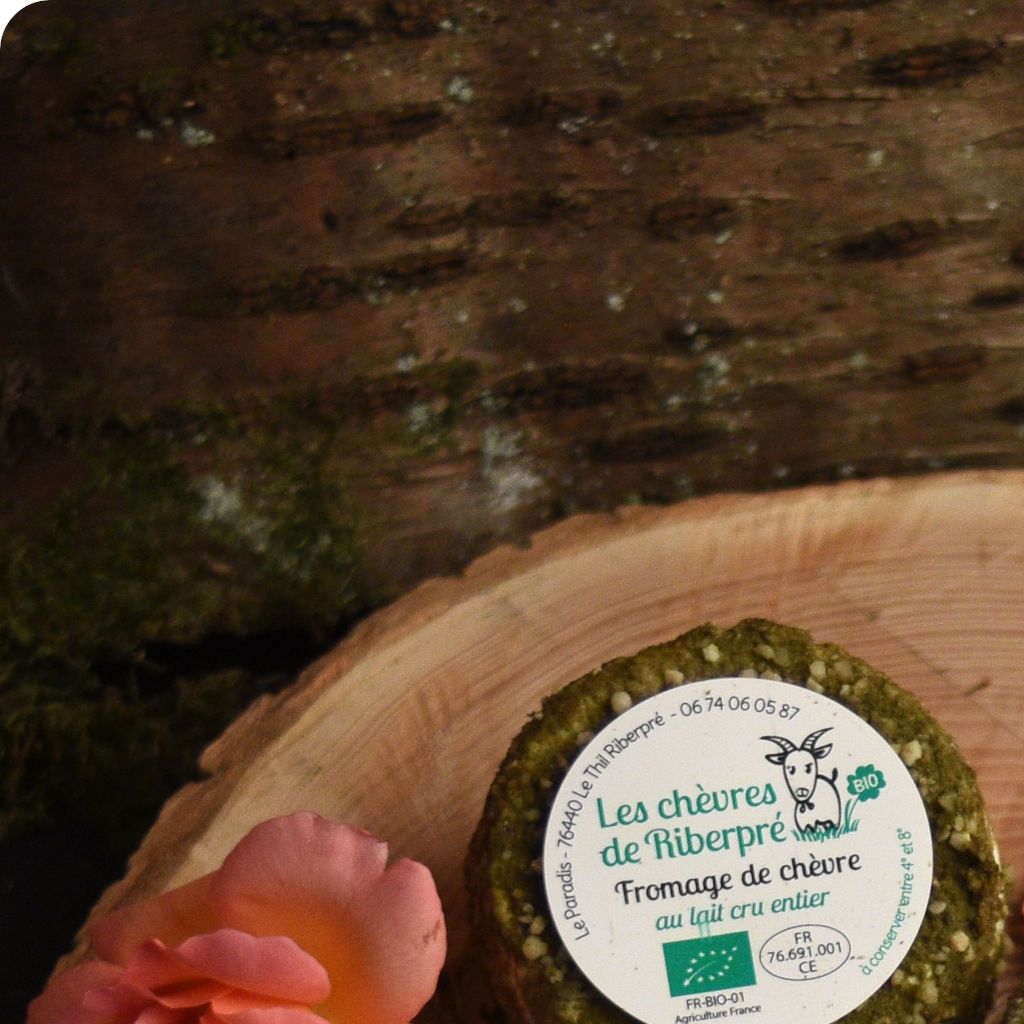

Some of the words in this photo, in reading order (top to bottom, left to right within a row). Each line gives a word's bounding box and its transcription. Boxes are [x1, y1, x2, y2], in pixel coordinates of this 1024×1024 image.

[680, 700, 703, 717] 06
[704, 696, 724, 712] 74
[728, 696, 751, 711] 06
[754, 698, 776, 715] 05
[779, 703, 800, 720] 87
[603, 711, 666, 759] Riberpré
[583, 754, 611, 779] Thil
[572, 780, 593, 799] Le
[853, 773, 878, 793] BIO
[596, 797, 649, 829] Les
[658, 783, 778, 820] chèvres
[557, 799, 583, 848] 76440
[601, 837, 641, 867] de
[644, 811, 787, 860] Riberpré
[903, 842, 914, 855] et
[614, 873, 734, 905] Fromage
[741, 864, 772, 887] de
[780, 853, 862, 881] chèvre
[556, 861, 581, 920] Paradis
[899, 873, 914, 907] entre
[656, 913, 683, 931] au
[690, 904, 725, 926] lait
[731, 902, 764, 920] cru
[771, 890, 830, 914] entier
[573, 919, 590, 941] Le
[794, 931, 812, 944] FR
[870, 907, 906, 967] conserver
[767, 941, 842, 963] 76.691.001
[798, 960, 817, 974] CE
[860, 965, 872, 976] à
[686, 992, 745, 1010] FR-BIO-01
[675, 1010, 728, 1024] Agriculture
[730, 1005, 761, 1016] France
